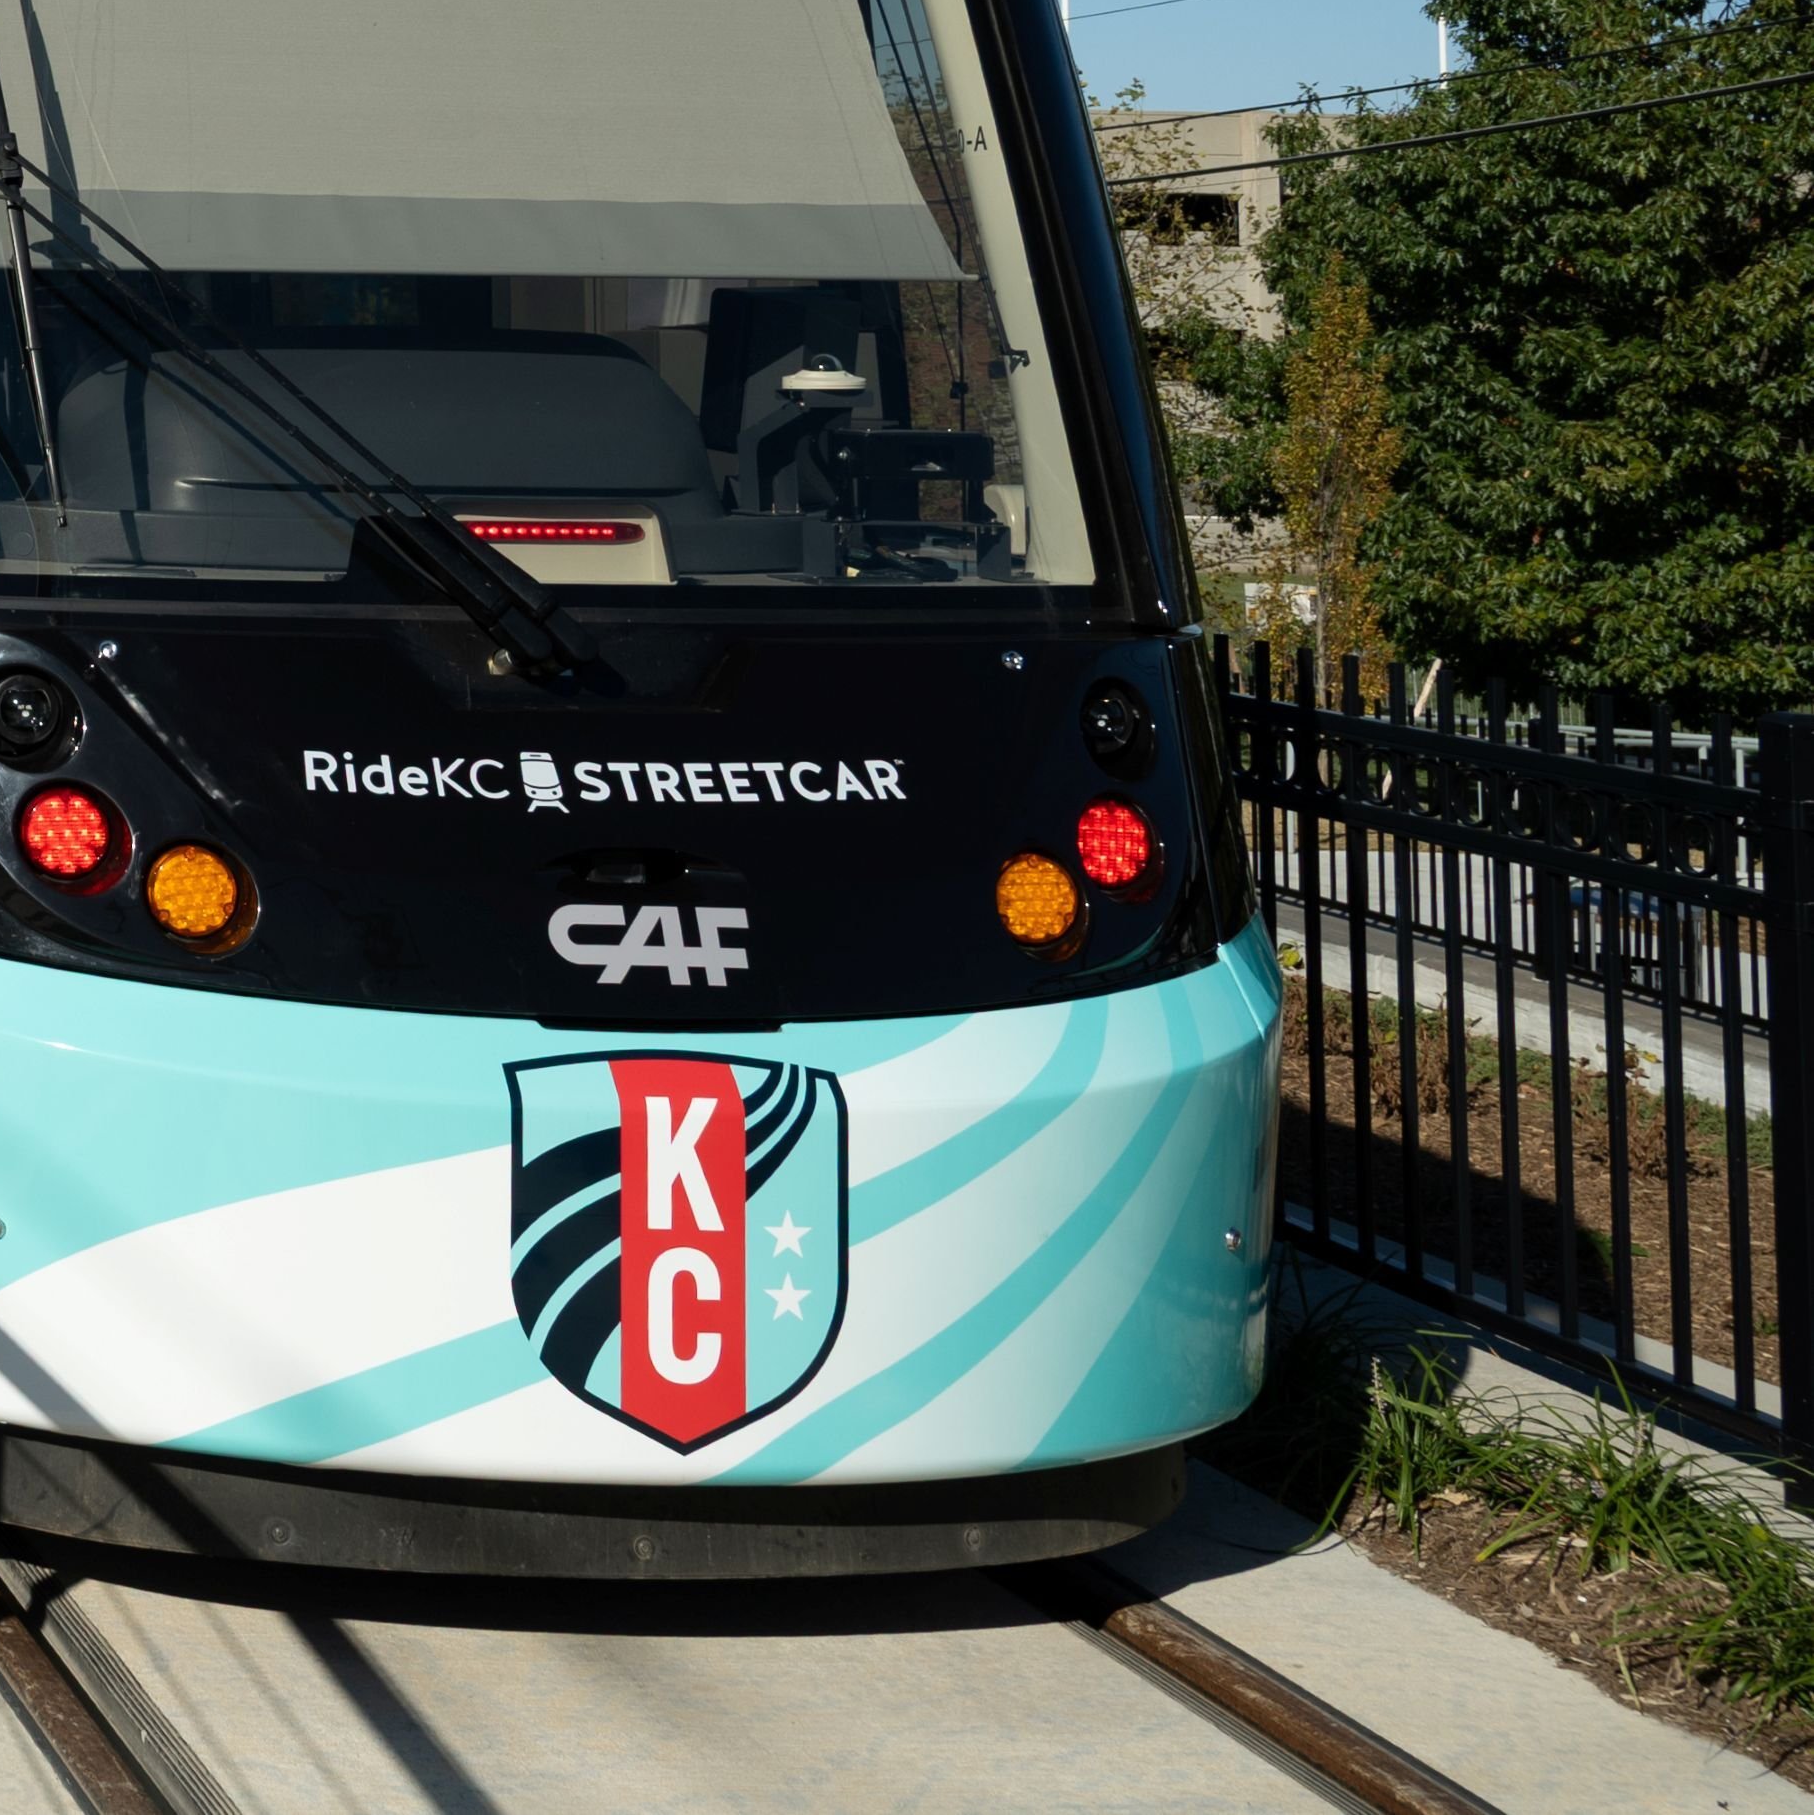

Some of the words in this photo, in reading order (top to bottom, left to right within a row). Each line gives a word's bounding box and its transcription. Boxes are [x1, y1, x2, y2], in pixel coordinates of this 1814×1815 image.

[304, 749, 506, 801] RideKC
[579, 759, 906, 803] STREETCAR
[548, 904, 750, 986] CAF
[646, 1095, 724, 1386] KC
